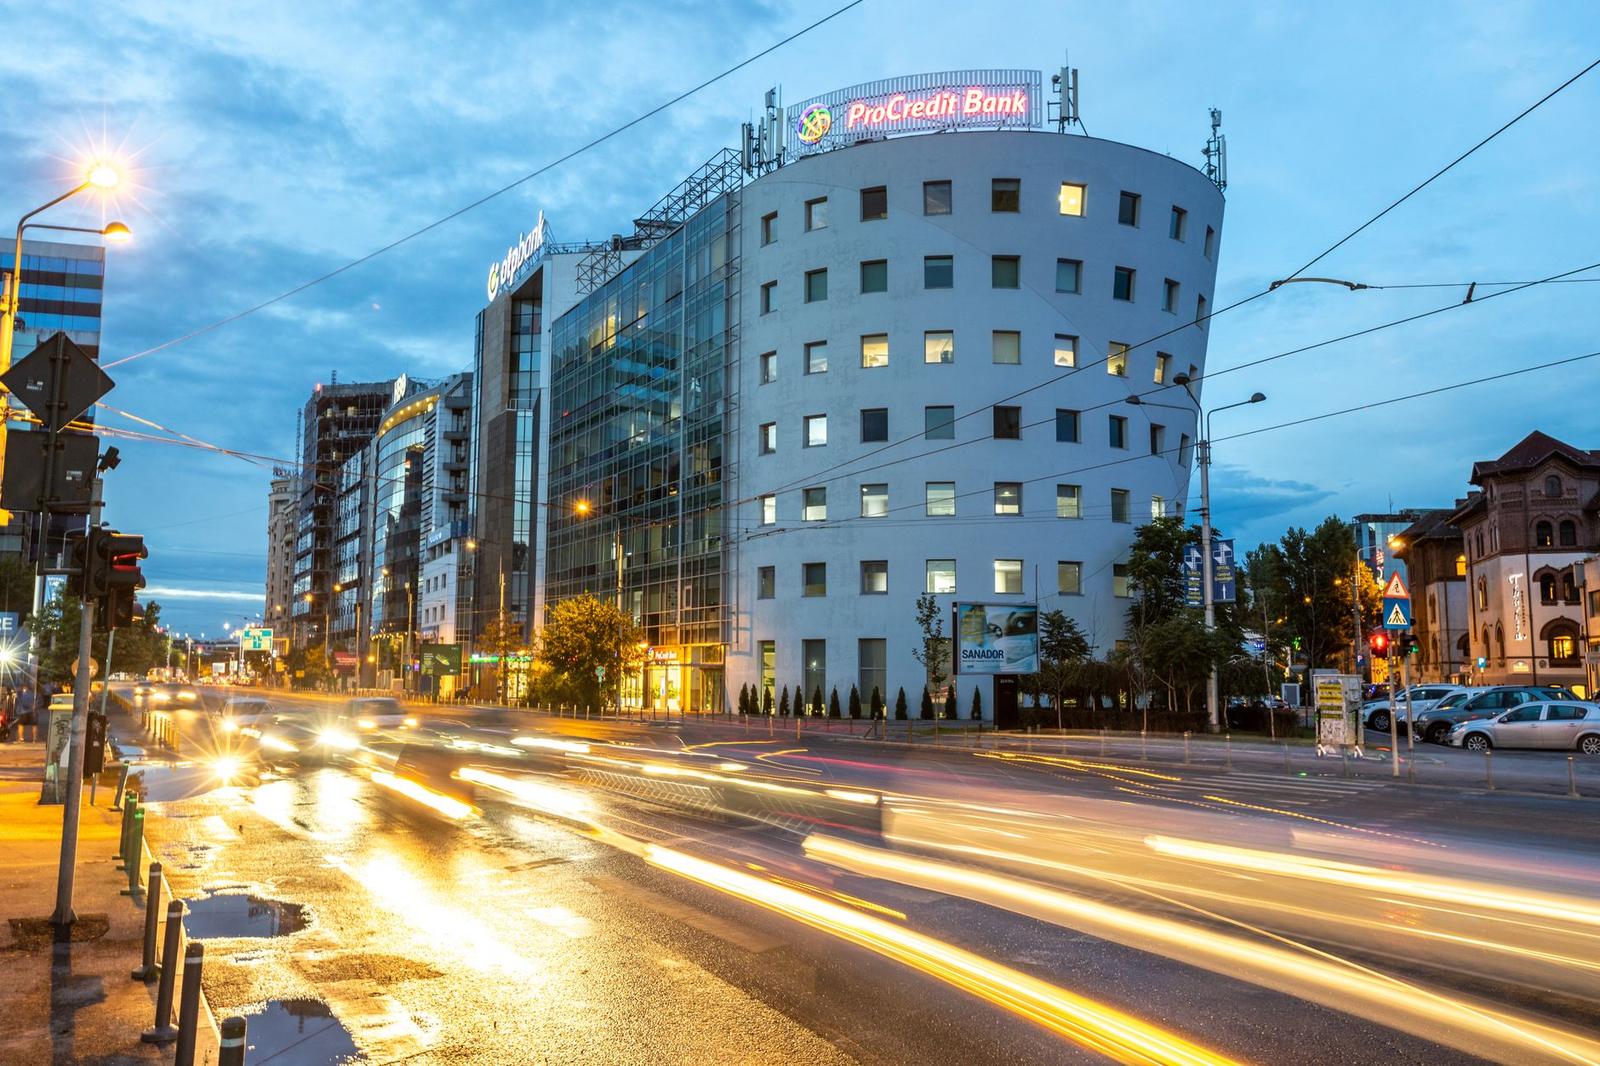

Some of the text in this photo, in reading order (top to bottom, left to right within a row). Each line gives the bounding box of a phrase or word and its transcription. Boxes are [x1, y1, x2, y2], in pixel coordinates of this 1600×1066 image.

[847, 89, 1026, 128] ProCredit Bank
[962, 649, 1004, 659] SANADOR
